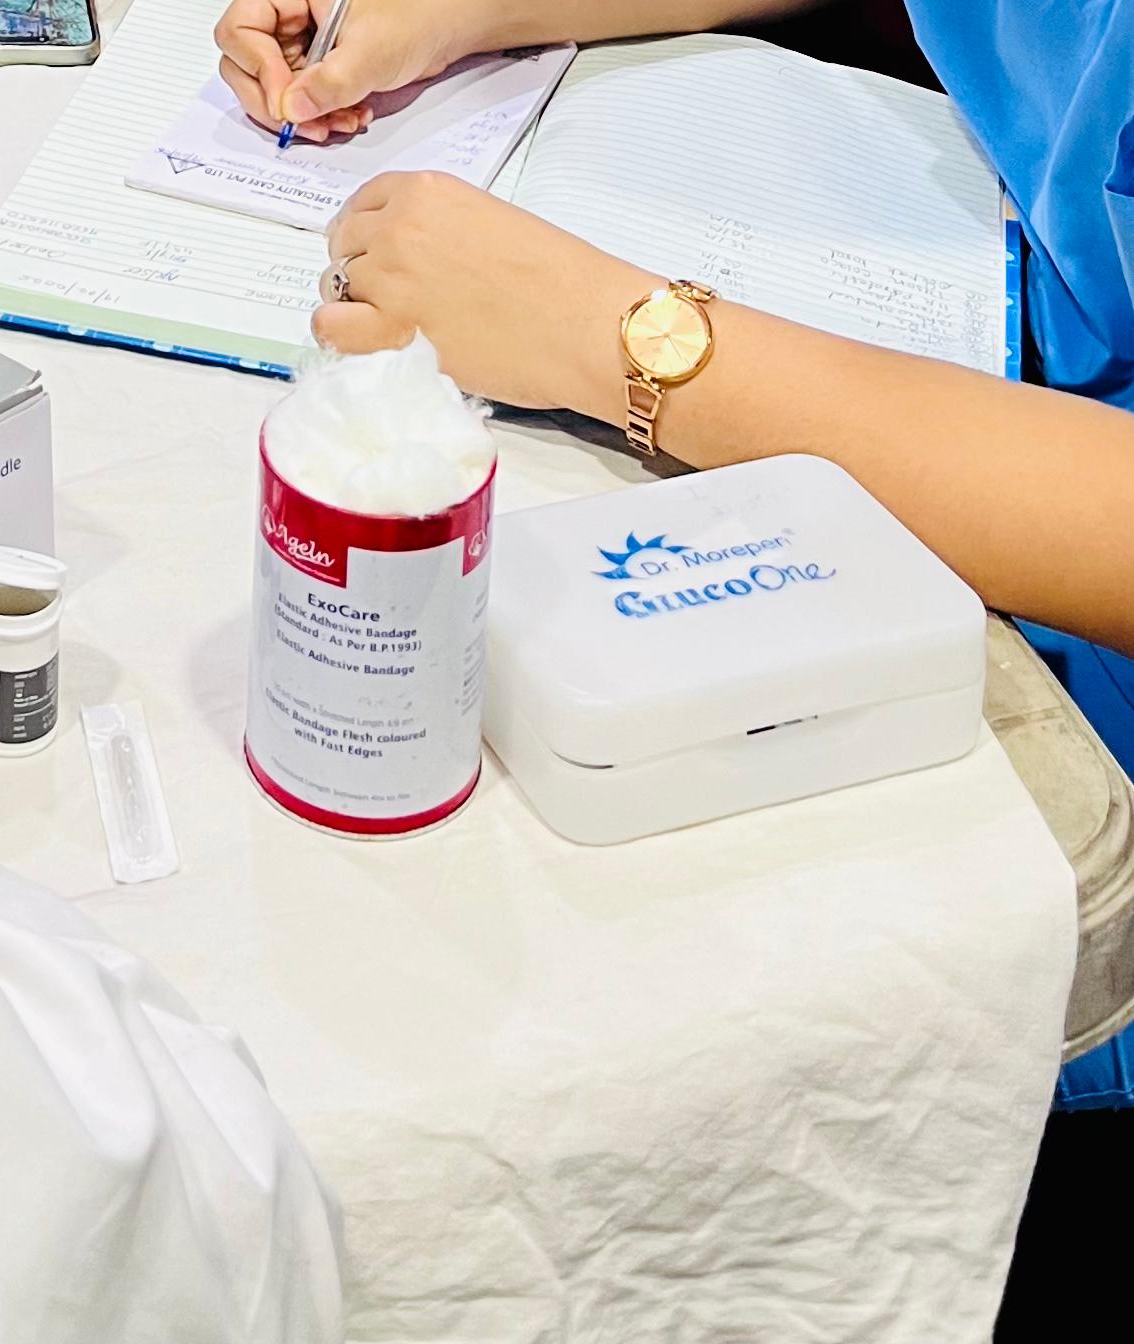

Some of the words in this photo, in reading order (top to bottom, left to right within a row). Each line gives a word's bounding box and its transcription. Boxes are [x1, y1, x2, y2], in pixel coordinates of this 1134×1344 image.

[640, 560, 677, 578] Dr.
[682, 535, 792, 570] Morepen
[307, 592, 381, 623] ExoCare
[310, 613, 362, 636] Adhesive
[366, 627, 417, 640] Bandage
[329, 634, 343, 647] As
[347, 639, 366, 651] Per
[308, 650, 360, 673] Adhesive
[364, 664, 415, 677] Bandage
[292, 709, 339, 737] Bandage
[342, 730, 373, 743] Flesh
[377, 728, 426, 743] coloured
[294, 727, 317, 744] with
[321, 738, 344, 753] Fast
[348, 745, 383, 758] Edges
